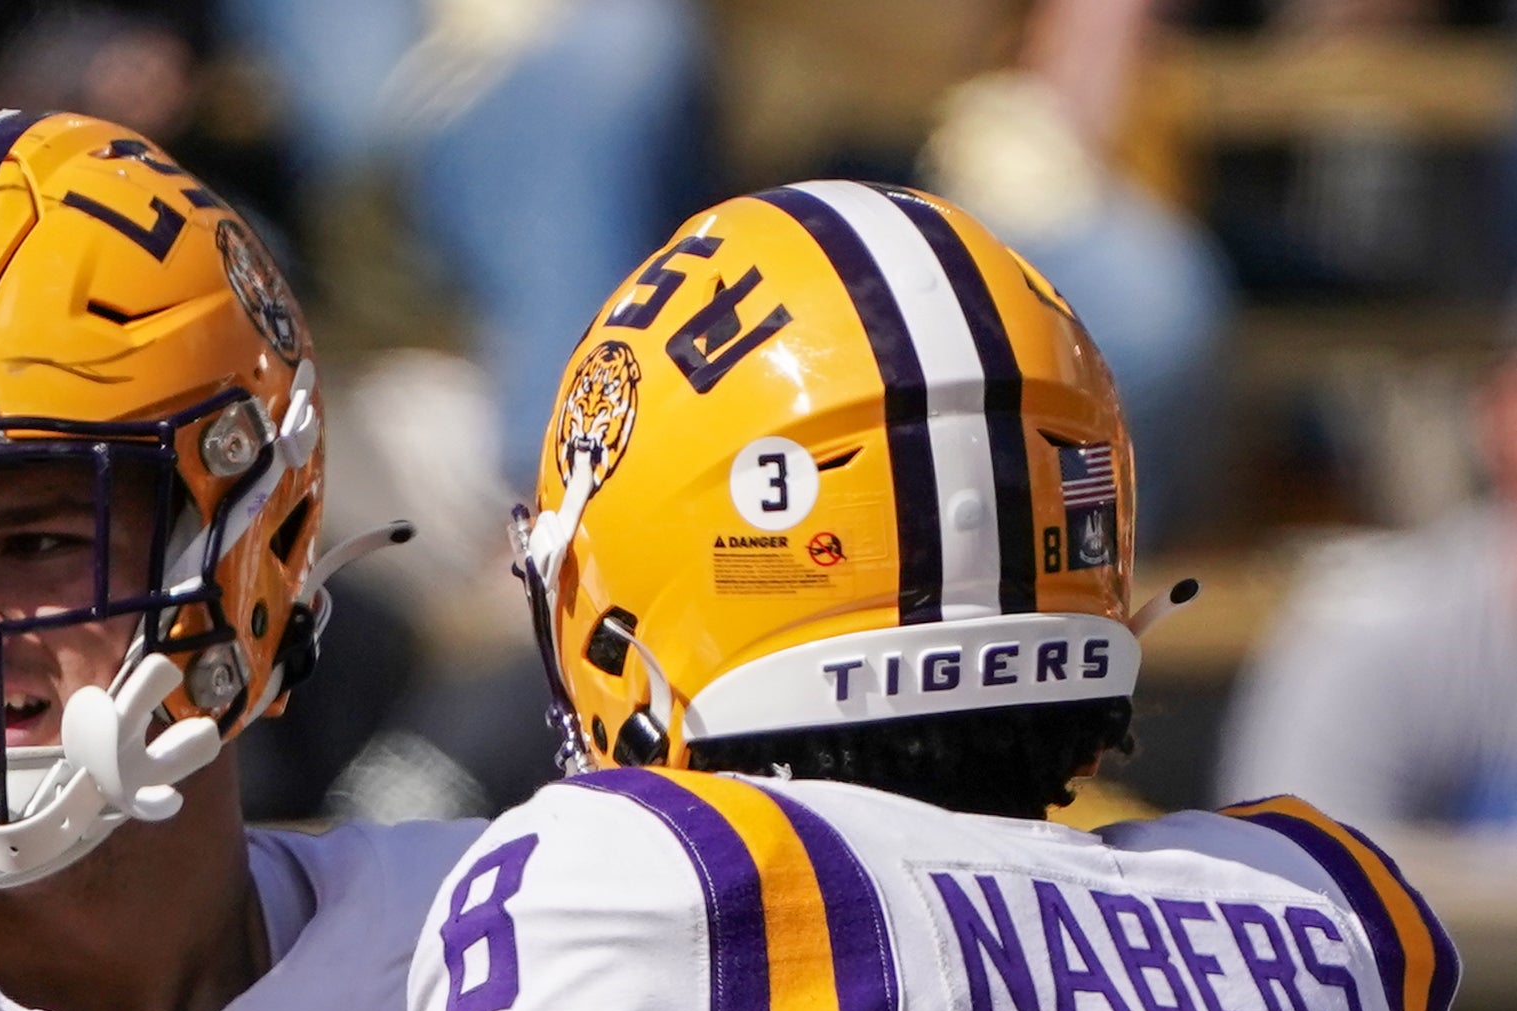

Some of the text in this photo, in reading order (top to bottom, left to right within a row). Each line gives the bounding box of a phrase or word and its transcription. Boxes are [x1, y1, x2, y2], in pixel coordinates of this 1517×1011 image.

[584, 235, 793, 394] SU
[758, 453, 788, 512] 3
[728, 536, 788, 548] DANGER
[1044, 526, 1061, 573] 8
[822, 638, 1109, 701] TIGERS
